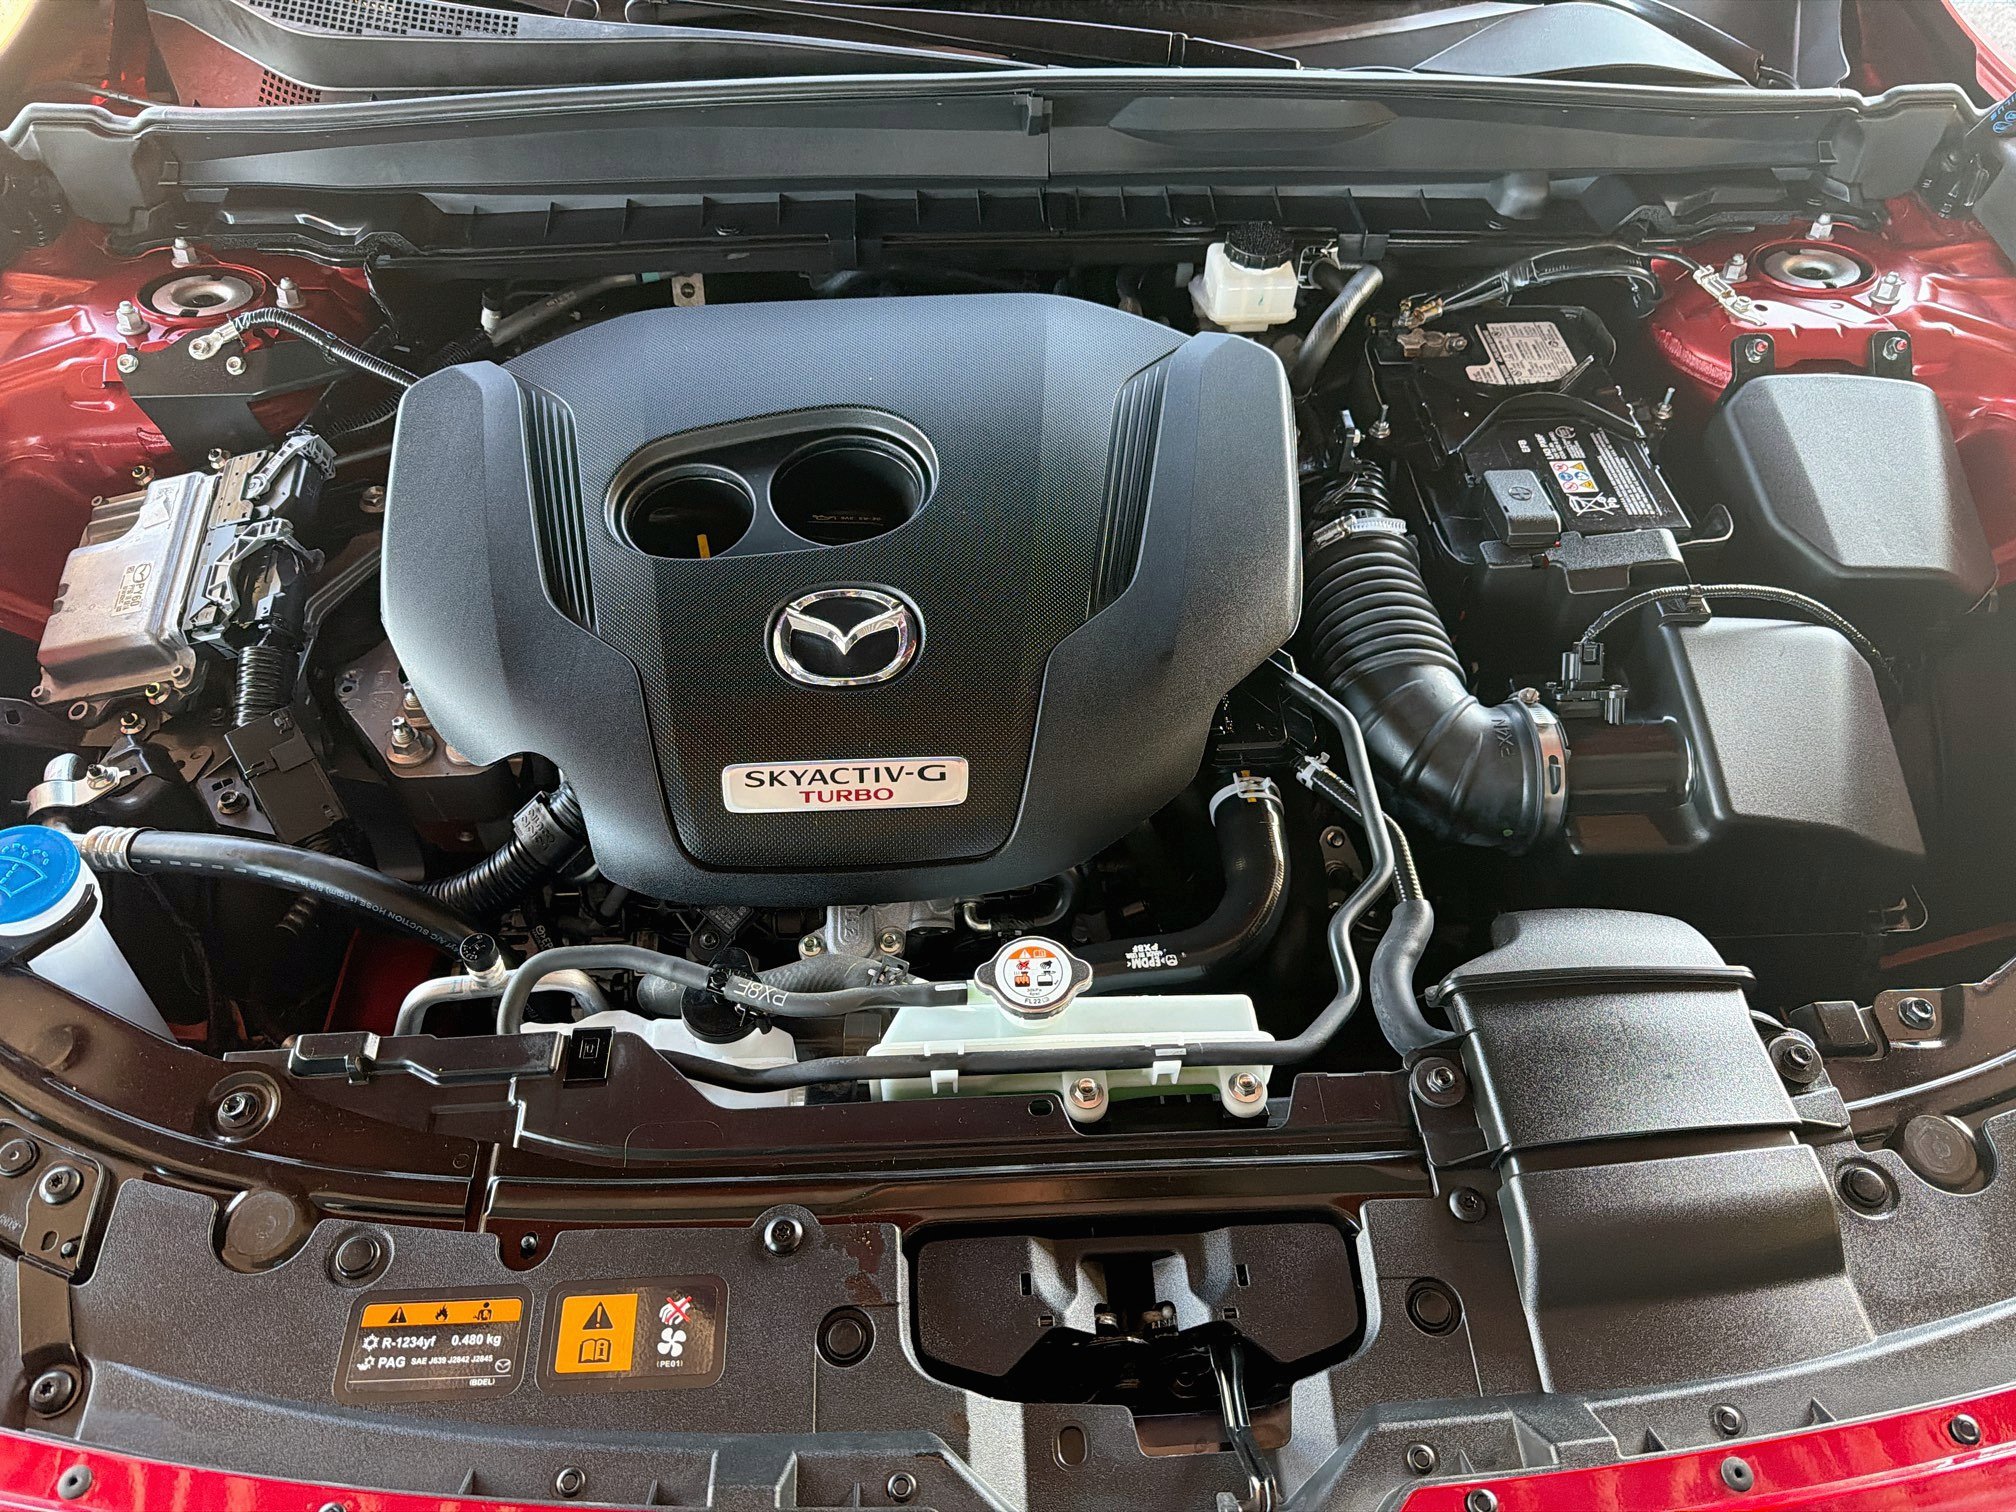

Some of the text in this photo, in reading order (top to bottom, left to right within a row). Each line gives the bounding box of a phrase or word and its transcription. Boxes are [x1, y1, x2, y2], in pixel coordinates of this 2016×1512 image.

[744, 764, 947, 788] SKYACTIV-G
[799, 787, 894, 804] TURBO
[359, 899, 387, 916] HOSE
[387, 911, 430, 936] SUCTION
[733, 980, 790, 1007] PX8F
[381, 1333, 502, 1350] R-1234yf 0.480 kg
[377, 1354, 494, 1369] PAG SAE J639 J2842 J2845
[656, 1359, 684, 1368] (PE01)
[469, 1378, 496, 1387] (BDEL)
